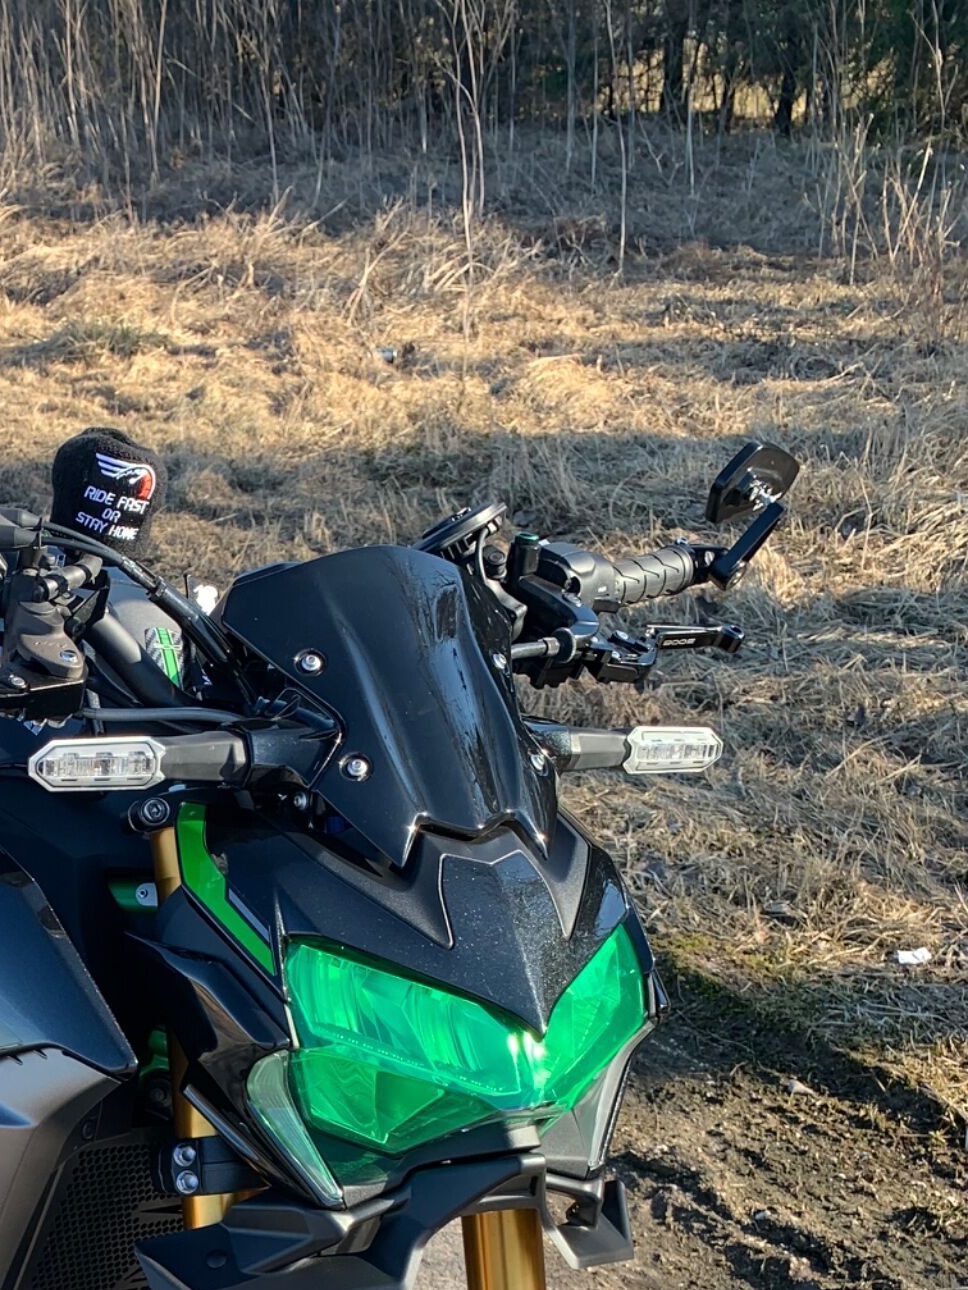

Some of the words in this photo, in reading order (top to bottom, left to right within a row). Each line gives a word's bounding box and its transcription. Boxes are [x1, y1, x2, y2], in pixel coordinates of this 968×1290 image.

[84, 485, 116, 506] RIDE
[117, 496, 150, 515] FAST
[75, 511, 108, 534] STAY
[108, 524, 139, 540] HOME
[102, 508, 122, 523] OR
